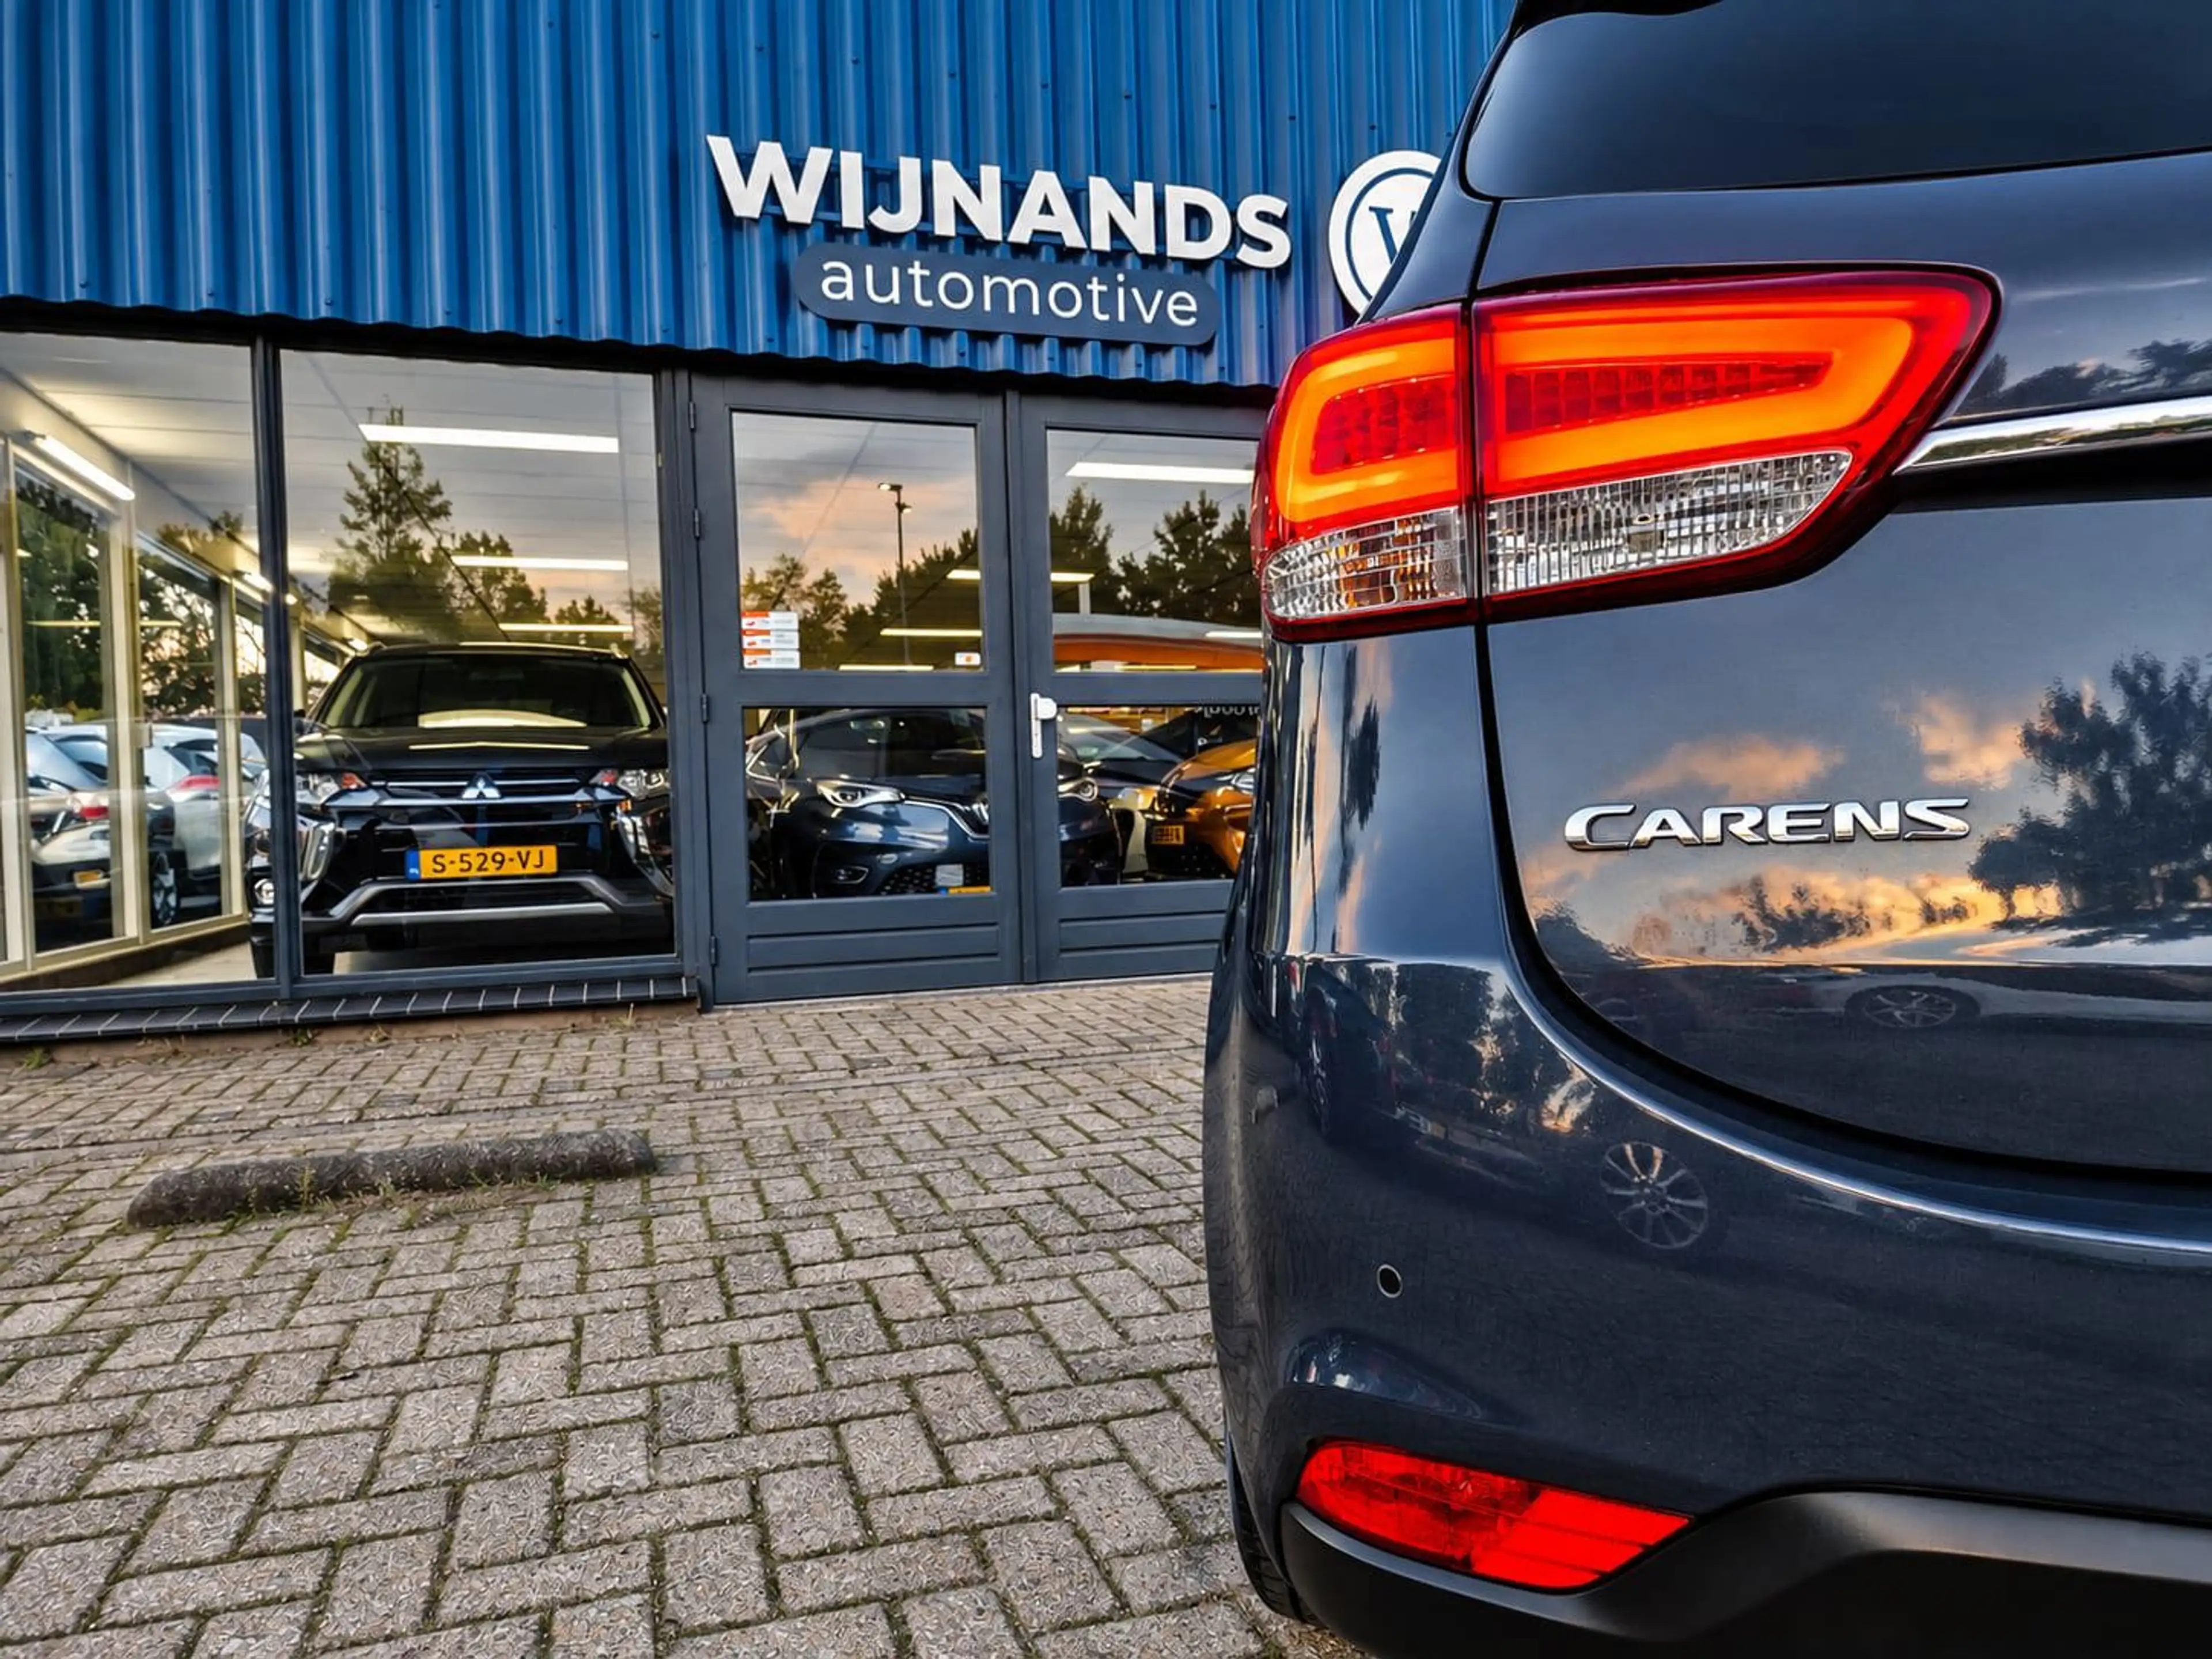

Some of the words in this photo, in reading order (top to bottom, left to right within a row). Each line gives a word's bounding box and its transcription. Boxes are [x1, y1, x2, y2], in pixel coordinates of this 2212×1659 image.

[707, 135, 1291, 269] WIJNANDS
[820, 259, 1199, 327] automotive
[1563, 798, 1971, 851] CARENS
[432, 849, 544, 873] S-529-VJ
